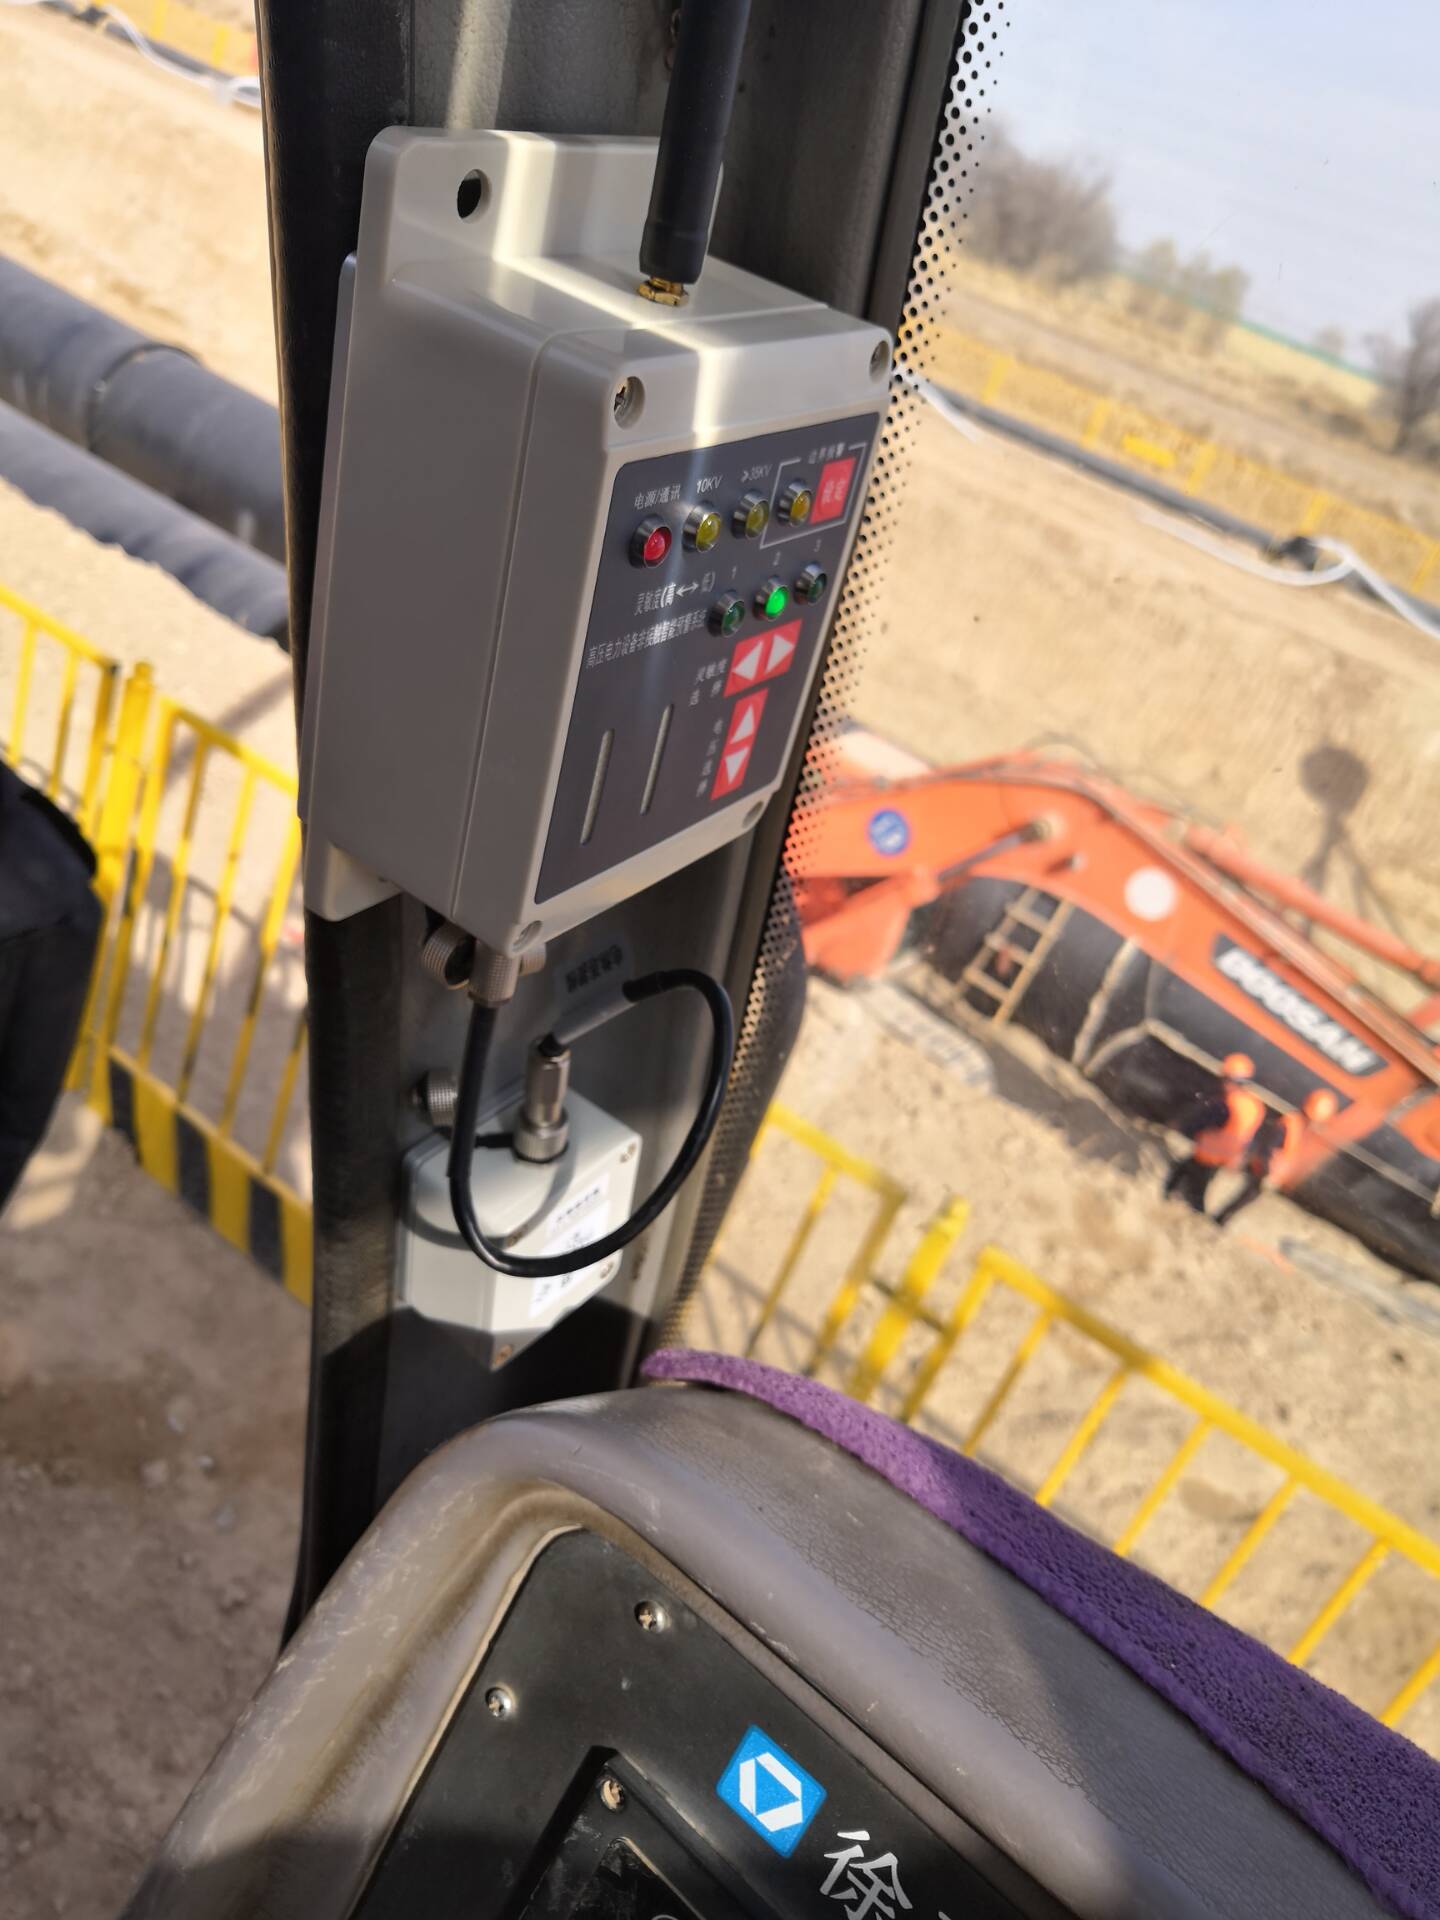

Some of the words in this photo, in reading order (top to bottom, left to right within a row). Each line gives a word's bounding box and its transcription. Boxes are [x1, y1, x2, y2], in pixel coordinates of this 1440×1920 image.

[696, 475, 723, 494] 10KV
[634, 483, 681, 509] 电源/通讯
